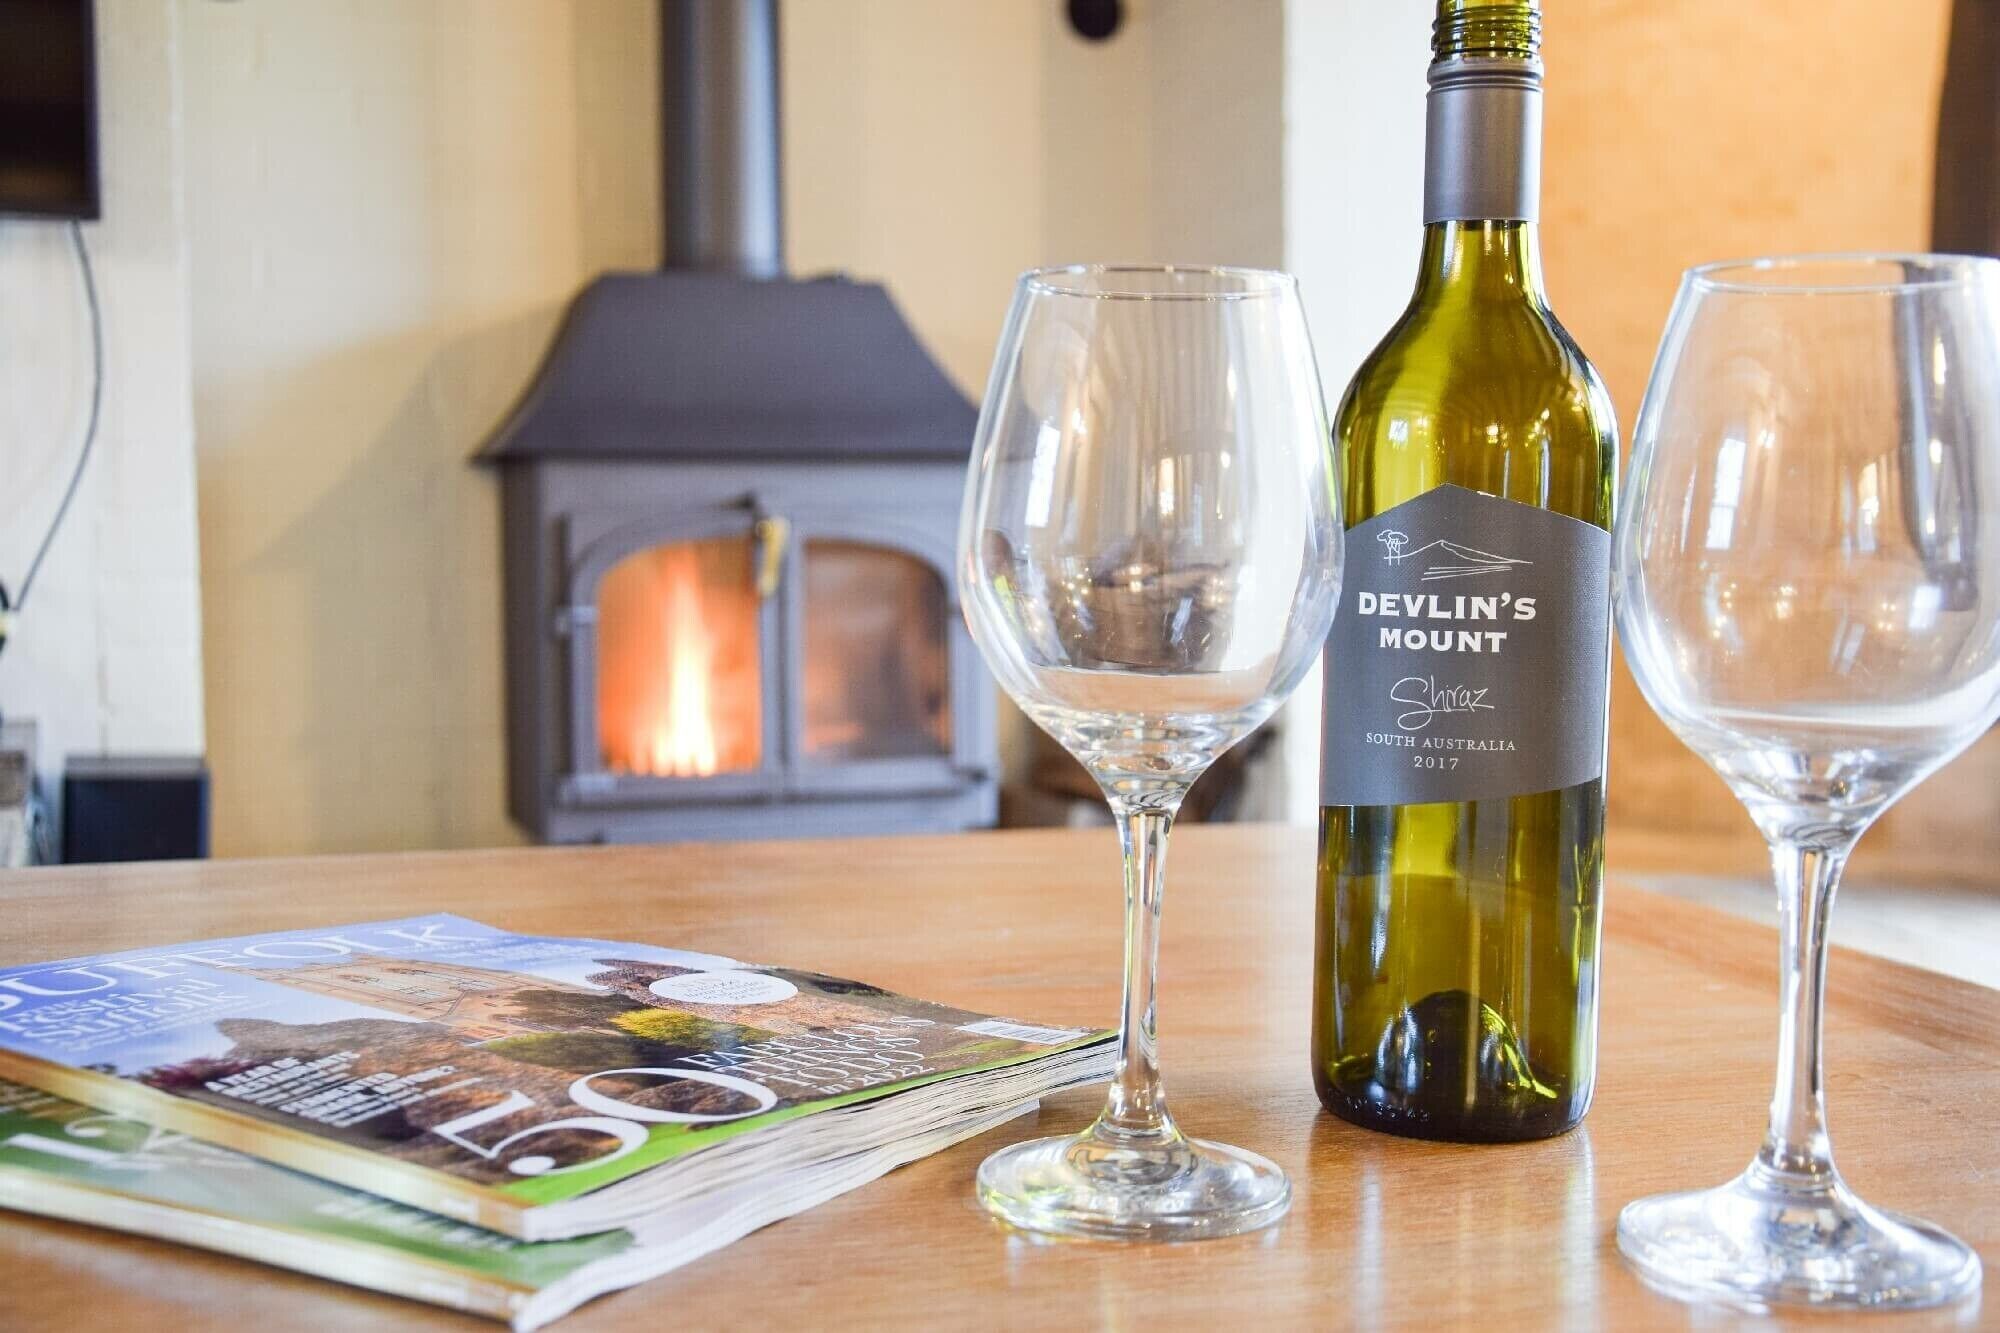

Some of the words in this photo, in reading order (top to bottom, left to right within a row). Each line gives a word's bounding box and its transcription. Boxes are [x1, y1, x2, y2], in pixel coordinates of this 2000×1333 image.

[1358, 591, 1537, 621] DEVLIN'S
[1379, 628, 1508, 653] MOUNT
[1390, 674, 1495, 731] Shiraz
[1366, 732, 1416, 748] SOUTH
[1423, 736, 1516, 752] AUSTRALIA
[1413, 755, 1460, 771] 2017
[674, 1015, 936, 1067] FABULOUS
[714, 1034, 920, 1077] THINGS
[756, 1066, 850, 1087] TO
[833, 1050, 925, 1072] DO
[812, 1084, 853, 1095] in
[844, 1064, 936, 1086] 2022
[432, 1067, 778, 1177] 50
